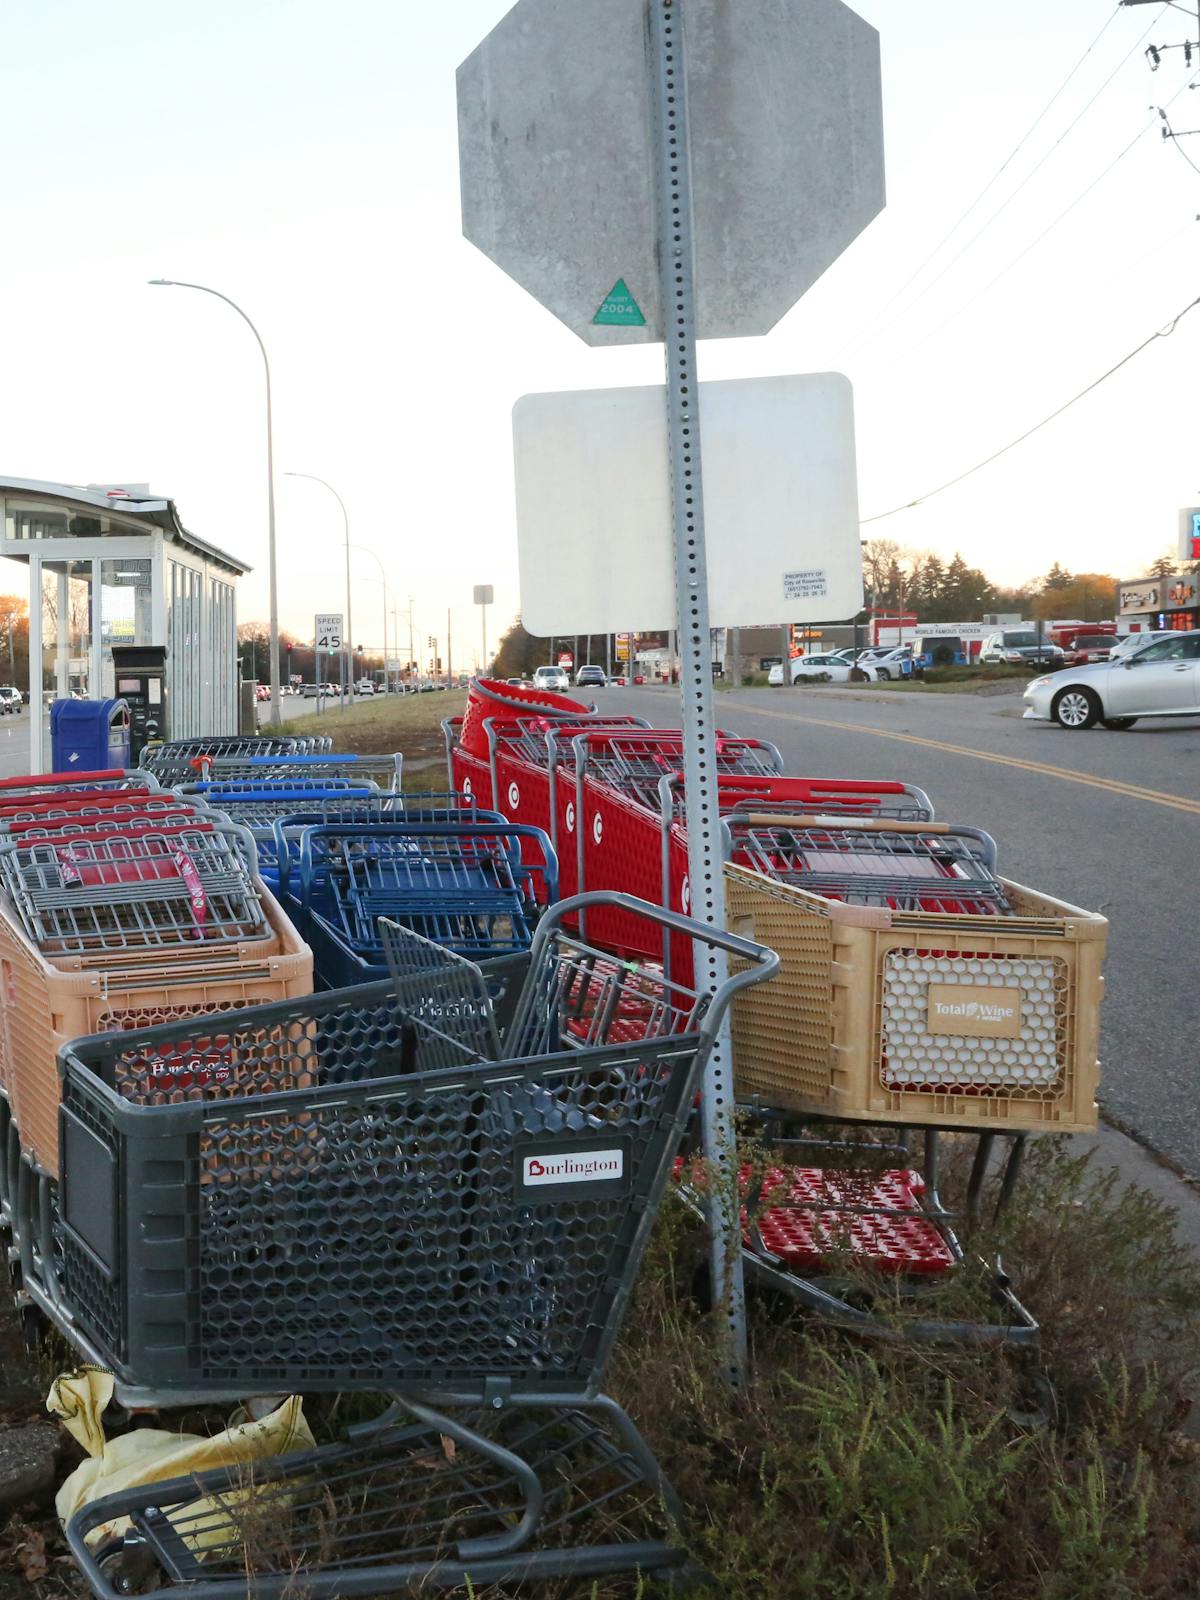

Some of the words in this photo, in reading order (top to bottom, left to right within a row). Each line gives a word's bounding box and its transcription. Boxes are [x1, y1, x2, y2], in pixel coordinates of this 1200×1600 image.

[601, 303, 633, 314] 2004
[318, 635, 341, 648] 45
[935, 1002, 966, 1015] Total
[979, 1004, 1014, 1017] Wine
[206, 1071, 230, 1079] Hppy
[528, 1160, 619, 1177] Burlington
